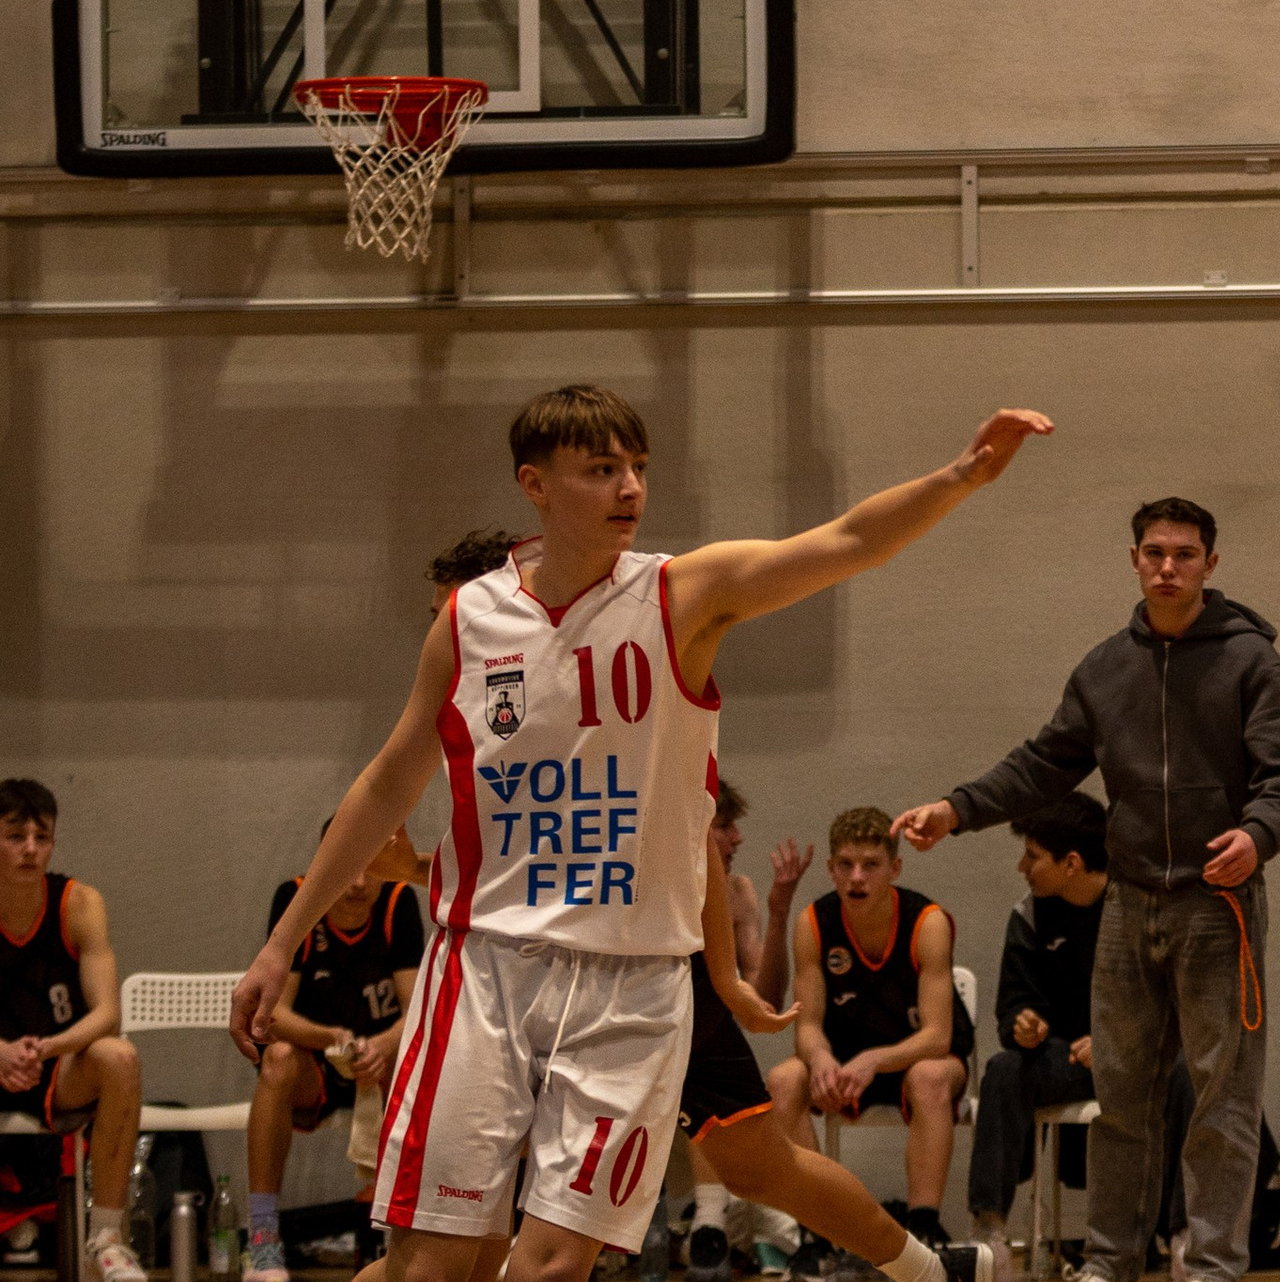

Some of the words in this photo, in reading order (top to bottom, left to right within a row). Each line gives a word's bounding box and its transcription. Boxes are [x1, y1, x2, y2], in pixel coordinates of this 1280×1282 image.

[100, 132, 167, 147] SPALDING
[484, 653, 524, 670] SPALDING
[573, 640, 652, 727] 10
[477, 755, 637, 804] VOLL
[492, 808, 637, 857] TREF
[526, 861, 635, 907] FER
[48, 983, 72, 1023] 8
[363, 979, 399, 1019] 12
[569, 1117, 648, 1207] 10
[437, 1184, 484, 1202] SPALDING
